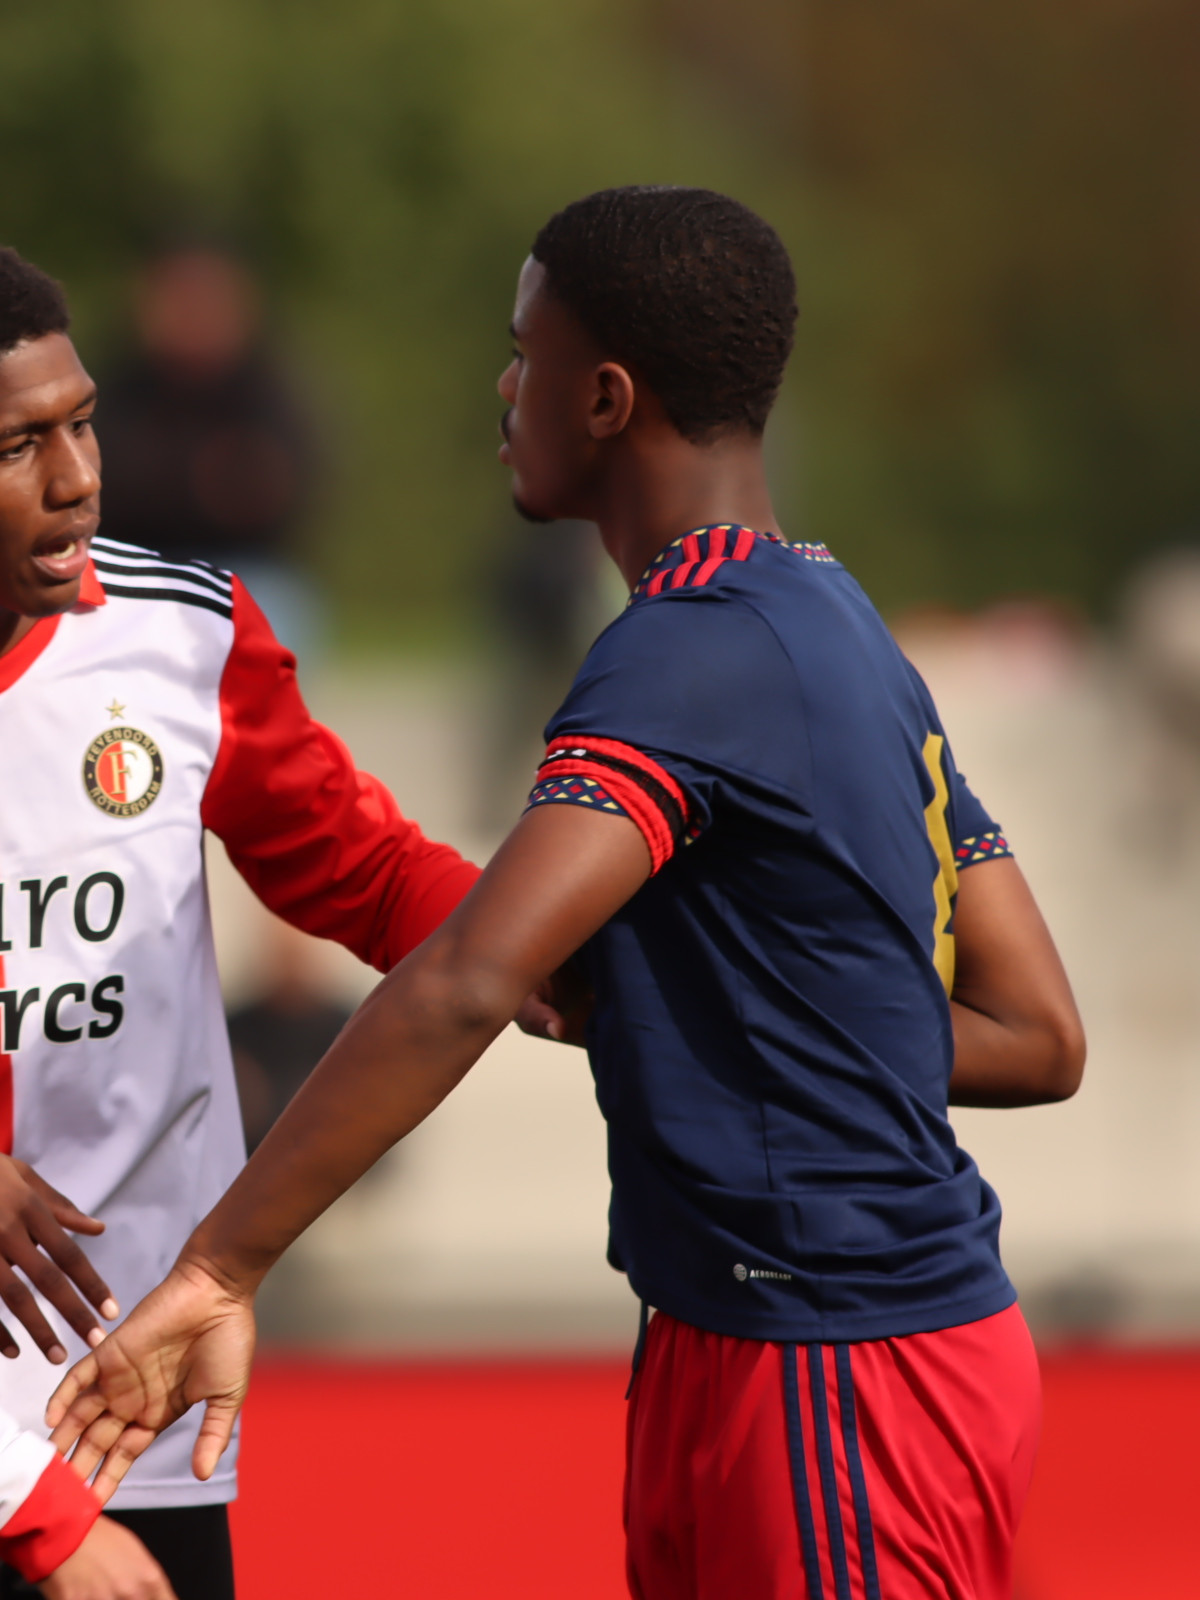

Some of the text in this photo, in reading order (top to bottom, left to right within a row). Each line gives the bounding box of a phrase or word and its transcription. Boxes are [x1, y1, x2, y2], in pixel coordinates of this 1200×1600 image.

[87, 728, 159, 763] FEYENOORD
[106, 749, 139, 796] F
[89, 780, 162, 816] ROTTERDAM
